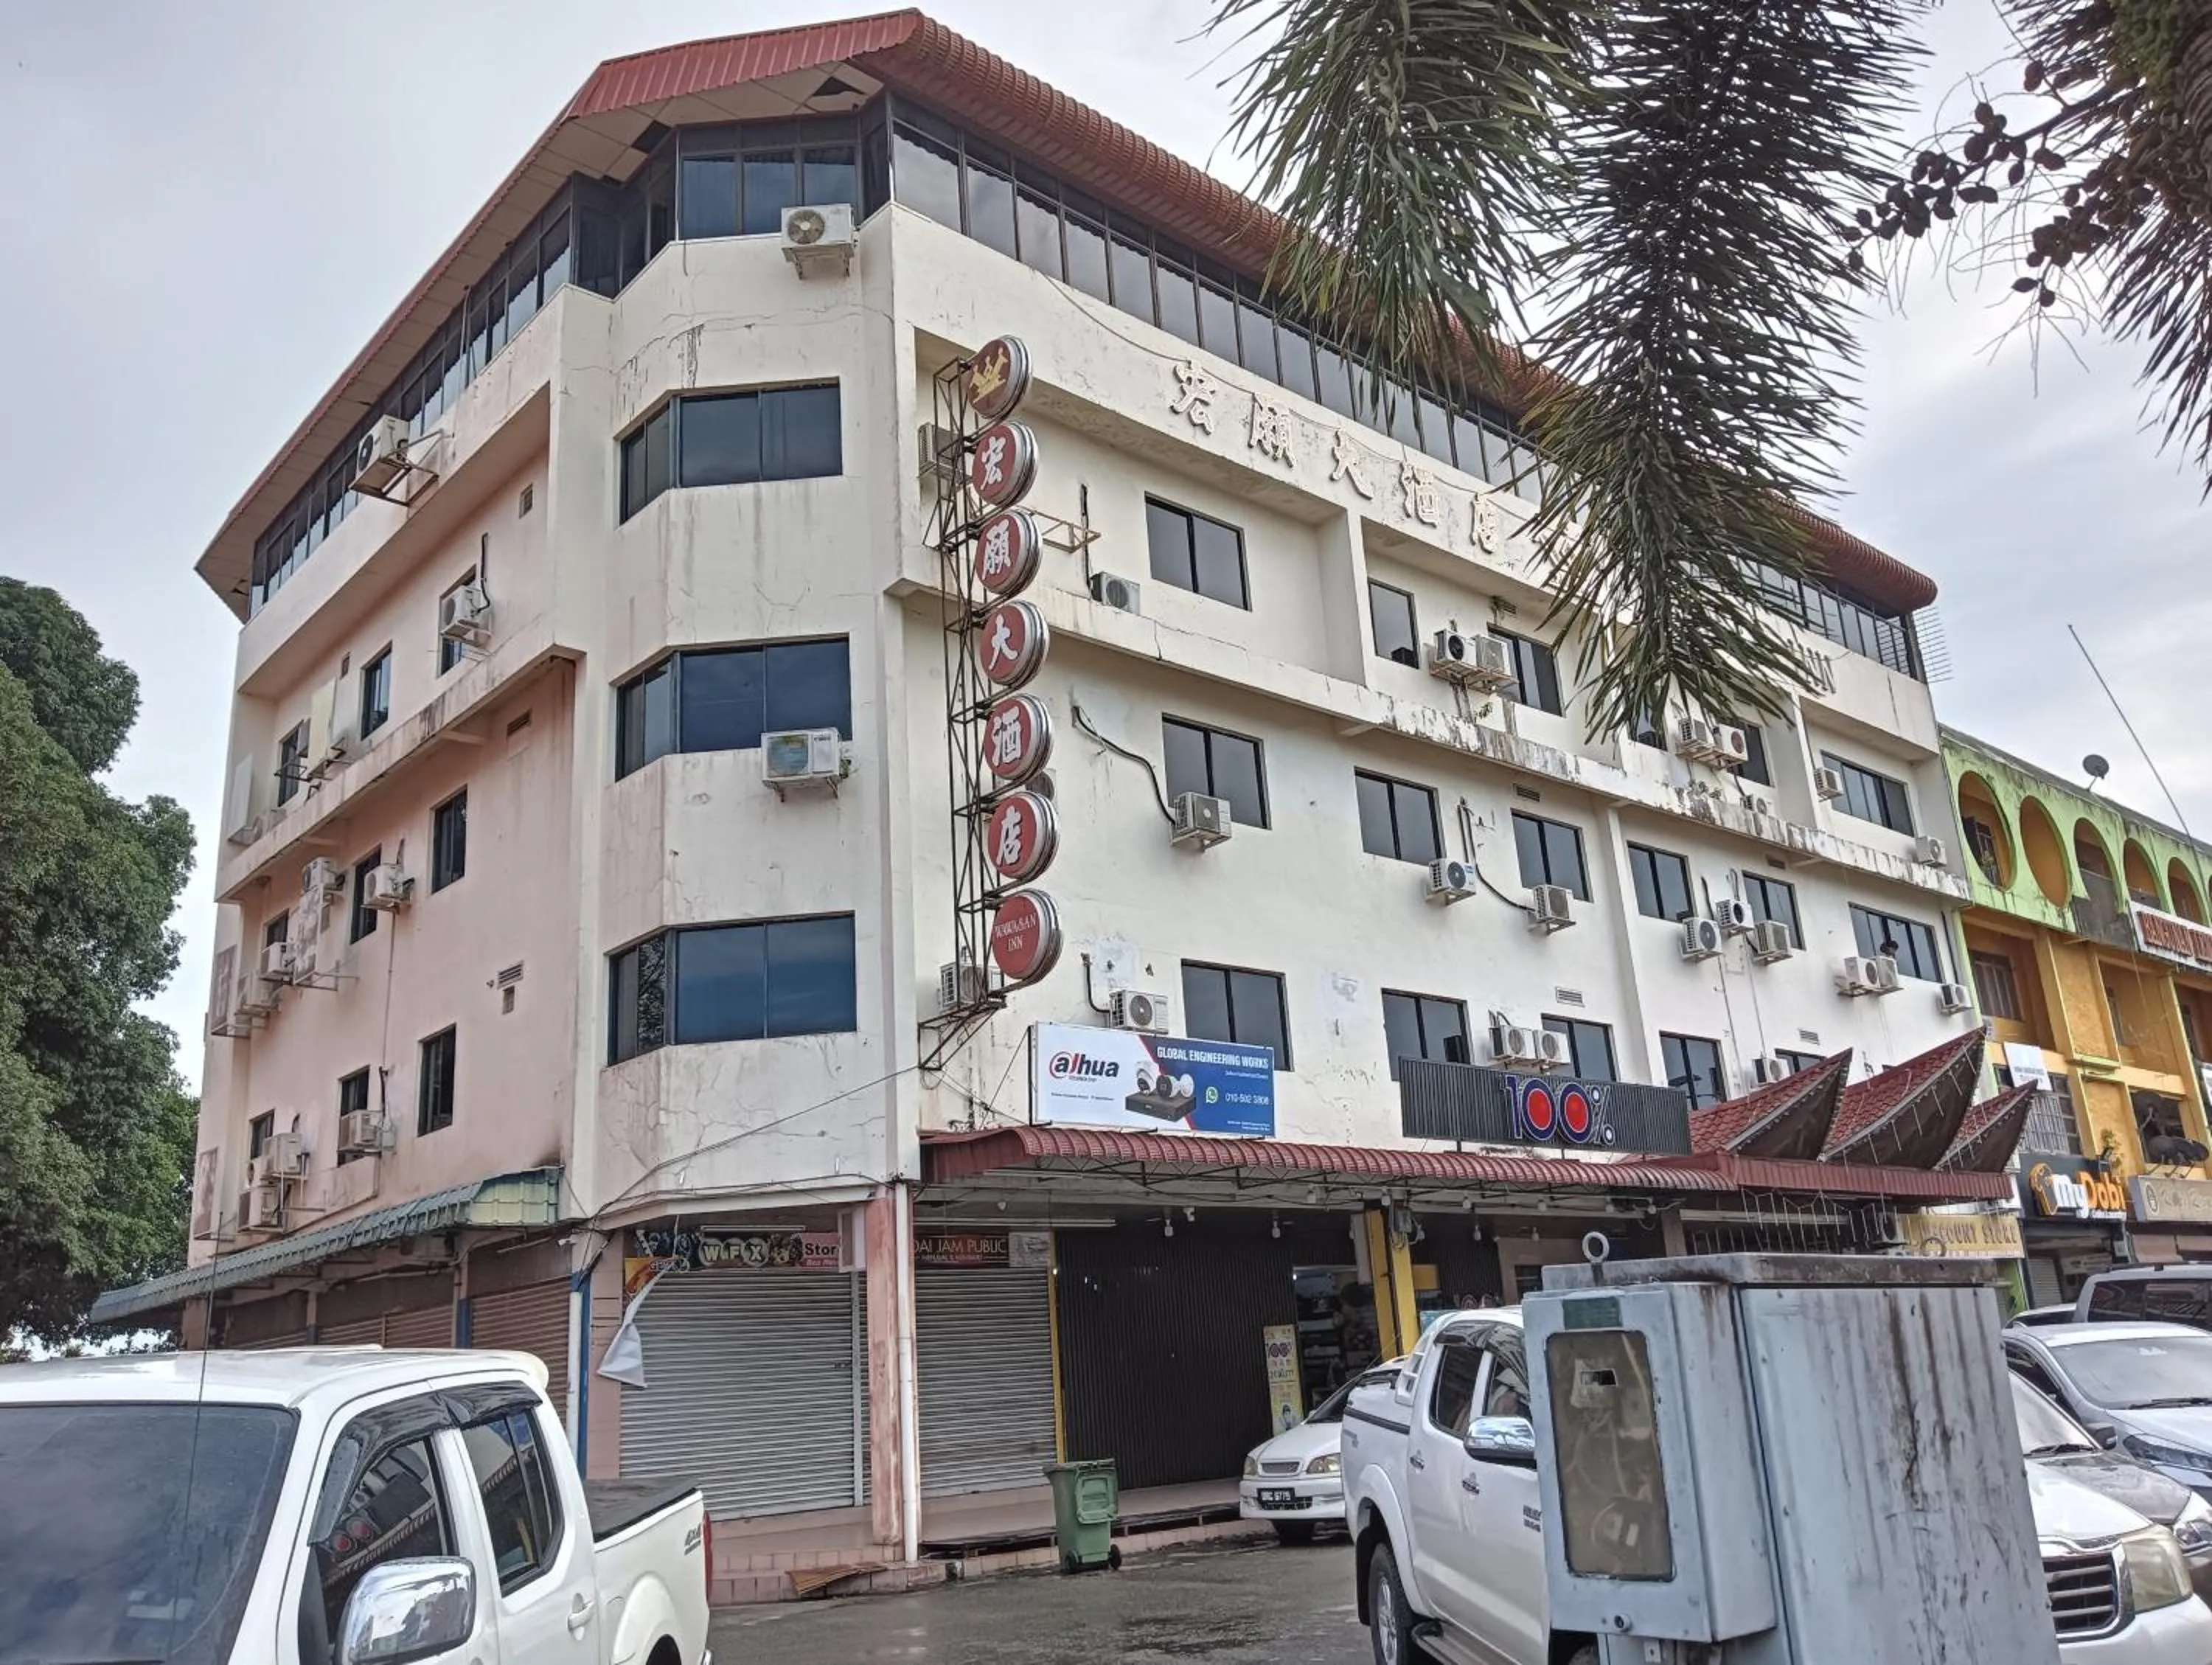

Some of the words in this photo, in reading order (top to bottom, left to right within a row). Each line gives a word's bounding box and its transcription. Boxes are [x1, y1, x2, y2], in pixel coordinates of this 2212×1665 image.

[994, 913, 1036, 938] WAWASAN
[1008, 935, 1023, 951] INN
[1157, 1046, 1188, 1060] GLOBAL
[1189, 1050, 1240, 1066] ENGINEERING
[1242, 1056, 1269, 1069] WORKS
[1506, 1074, 1615, 1145] 100%
[804, 1242, 841, 1256] Stor
[936, 1238, 963, 1253] JAM
[967, 1238, 1007, 1253] PUBLIC
